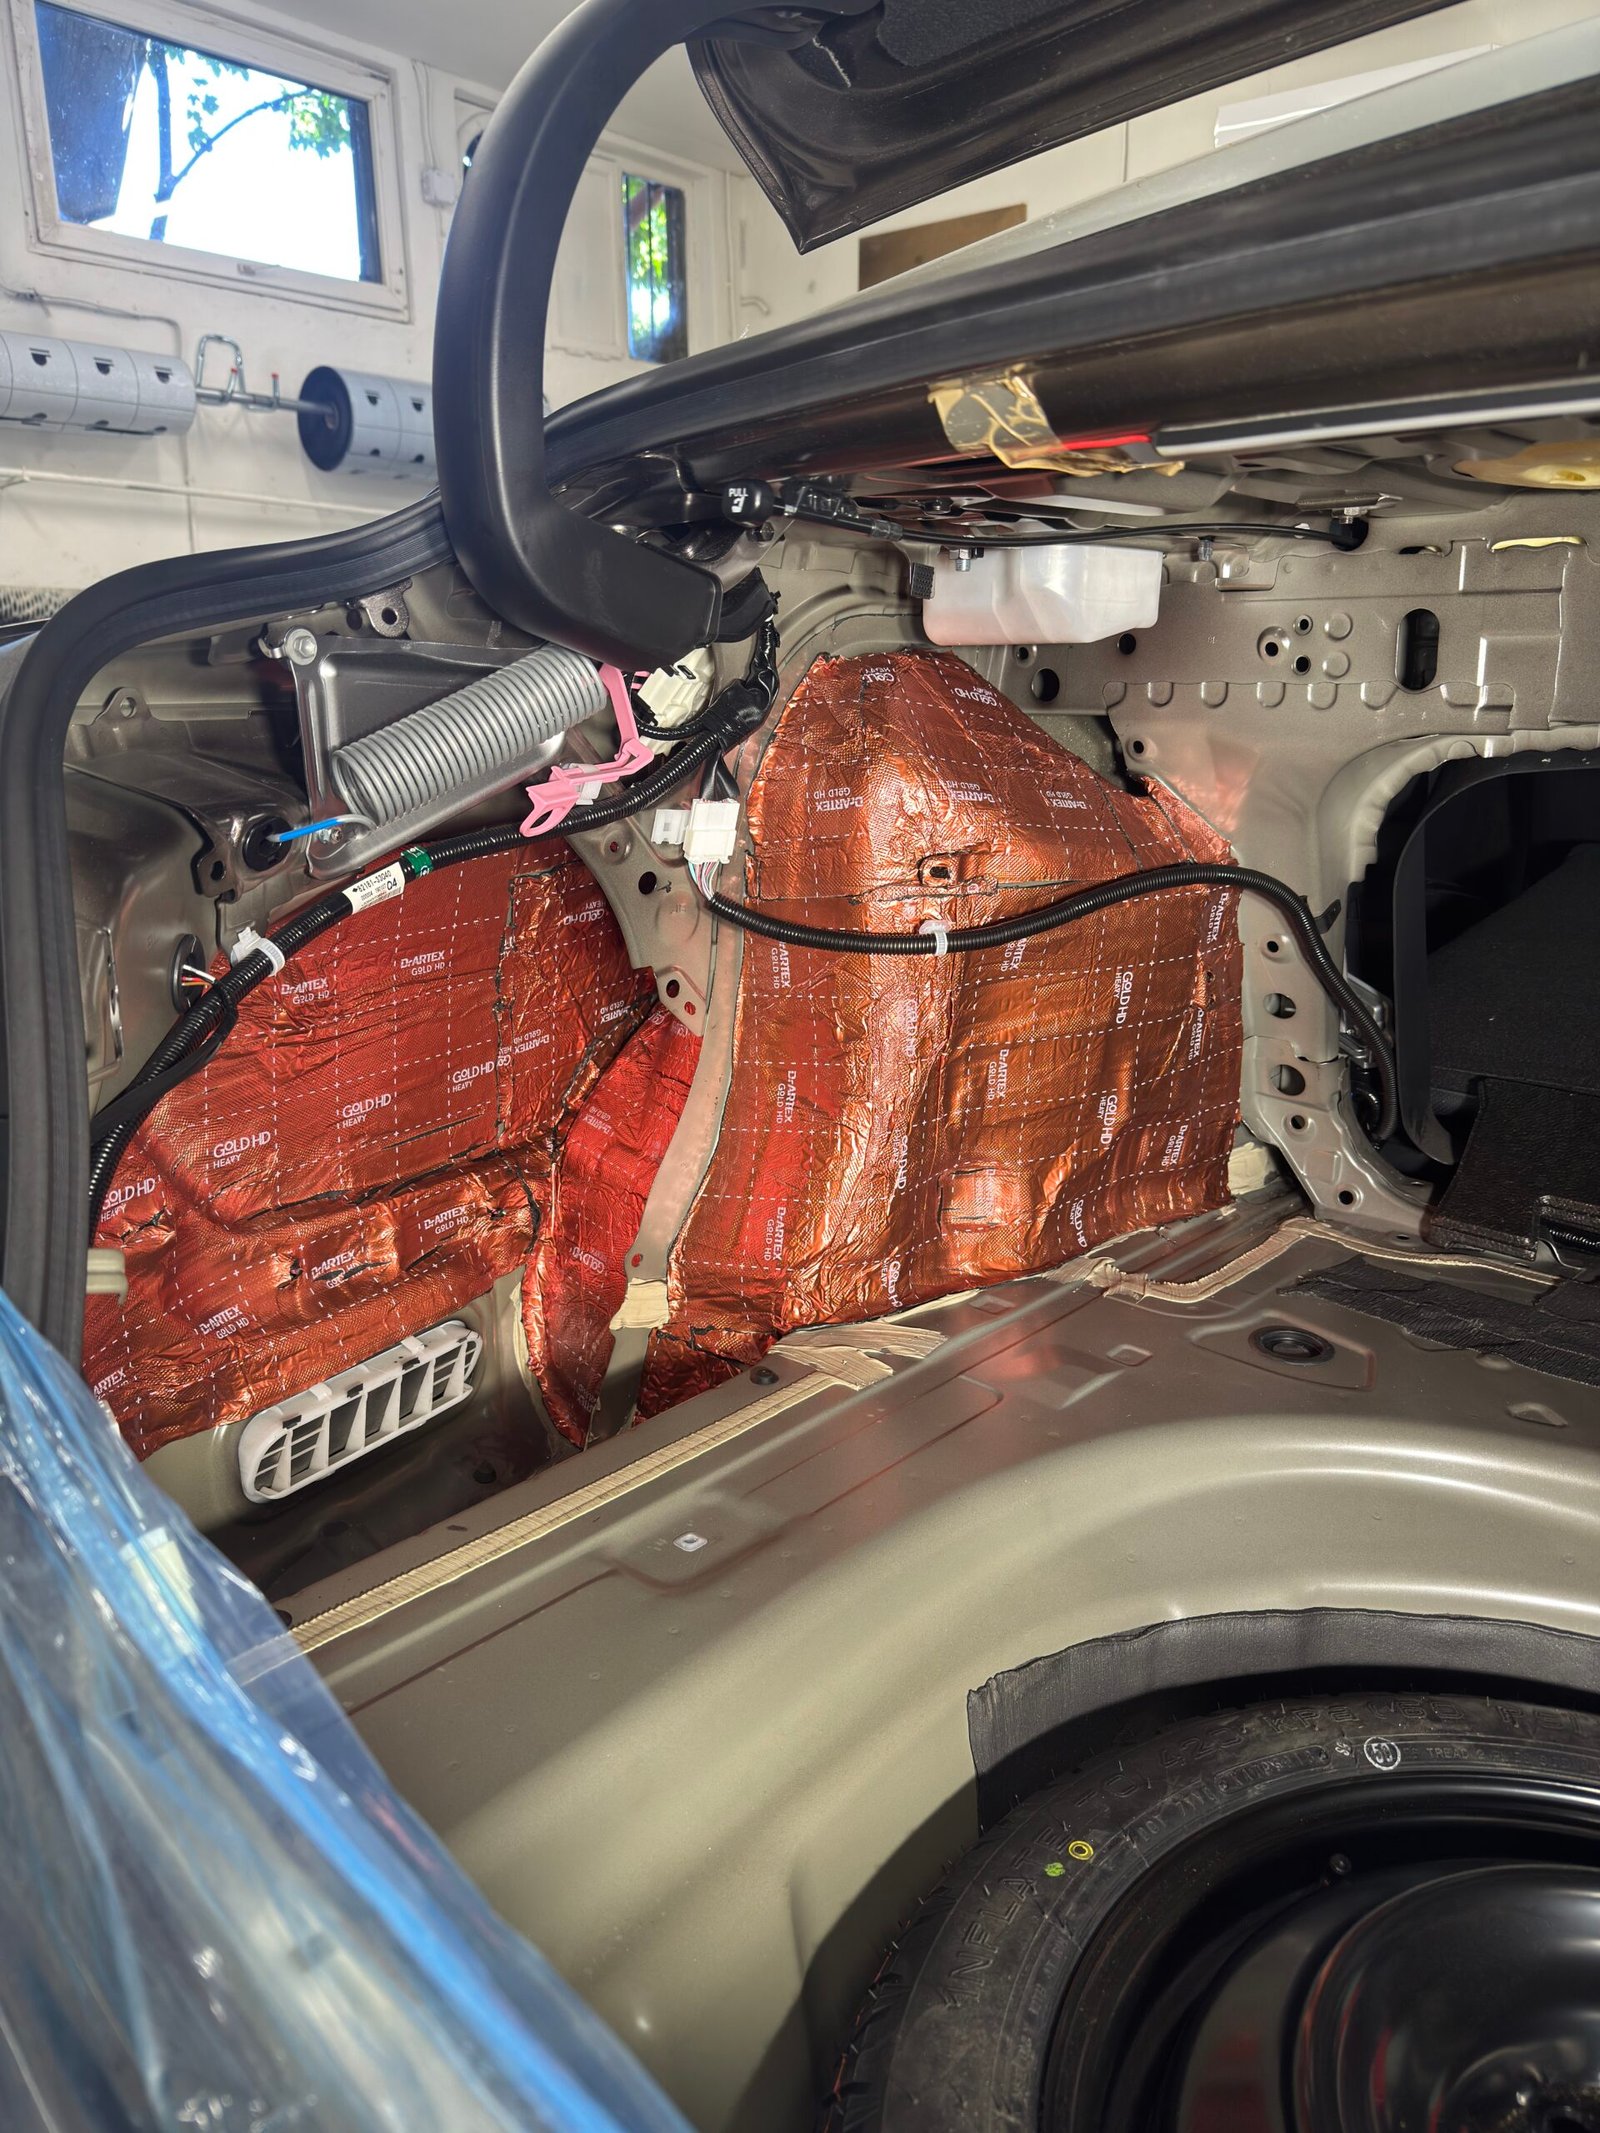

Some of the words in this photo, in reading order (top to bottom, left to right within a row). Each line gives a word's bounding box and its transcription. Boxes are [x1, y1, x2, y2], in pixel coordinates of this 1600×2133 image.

[729, 488, 748, 498] PULL
[813, 791, 826, 799] HD
[828, 788, 850, 798] GOLD
[580, 908, 605, 924] GOLD
[401, 951, 446, 969] DrARTEX
[771, 947, 779, 973] GOLD
[1004, 942, 1015, 958] OLD
[1010, 938, 1027, 970] ARTEX
[411, 964, 432, 977] GOLD
[433, 962, 446, 973] HD
[779, 942, 791, 988] rARTEX
[1000, 960, 1011, 972] HD
[281, 977, 329, 995] DrARTEX
[773, 975, 780, 989] HD
[1113, 972, 1122, 998] HEAVY
[1121, 971, 1134, 1006] GOLD
[292, 992, 315, 1004] GOLD
[316, 990, 330, 1000] HD
[1115, 1006, 1128, 1024] HD
[524, 1029, 542, 1042] GOLD
[452, 1063, 480, 1083] GOLD
[480, 1060, 495, 1075] HD
[989, 1061, 997, 1085] GOLD
[452, 1080, 473, 1093] HEAVY
[342, 1098, 374, 1118] GOLD
[374, 1094, 392, 1109] HD
[784, 1071, 796, 1123] DrARTEX
[776, 1110, 783, 1124] HD
[1097, 1096, 1107, 1120] HEAVY
[1104, 1095, 1118, 1126] GOLD
[342, 1112, 367, 1129] HEAVY
[213, 1136, 251, 1158] GOLD
[251, 1131, 271, 1146] HD
[1100, 1126, 1113, 1144] HD
[1165, 1135, 1176, 1155] GOLD
[213, 1153, 242, 1169] HEAVY
[137, 1178, 156, 1196] HD
[101, 1204, 126, 1223] HEAVY
[424, 1206, 469, 1230] DrARTEX
[1073, 1199, 1084, 1230] GOLD
[434, 1220, 455, 1235] GOLD
[456, 1215, 469, 1226] HD
[764, 1219, 774, 1245] GOLD
[773, 1206, 787, 1261] DrARTEX
[1076, 1229, 1088, 1248] HD
[311, 1249, 356, 1279] DrARTEX
[763, 1247, 771, 1261] HD
[887, 1260, 900, 1293] GOLD
[200, 1304, 243, 1335] DrARTEX
[216, 1321, 236, 1340] GOLD
[237, 1317, 250, 1329] HD
[93, 1368, 127, 1396] ARTEX
